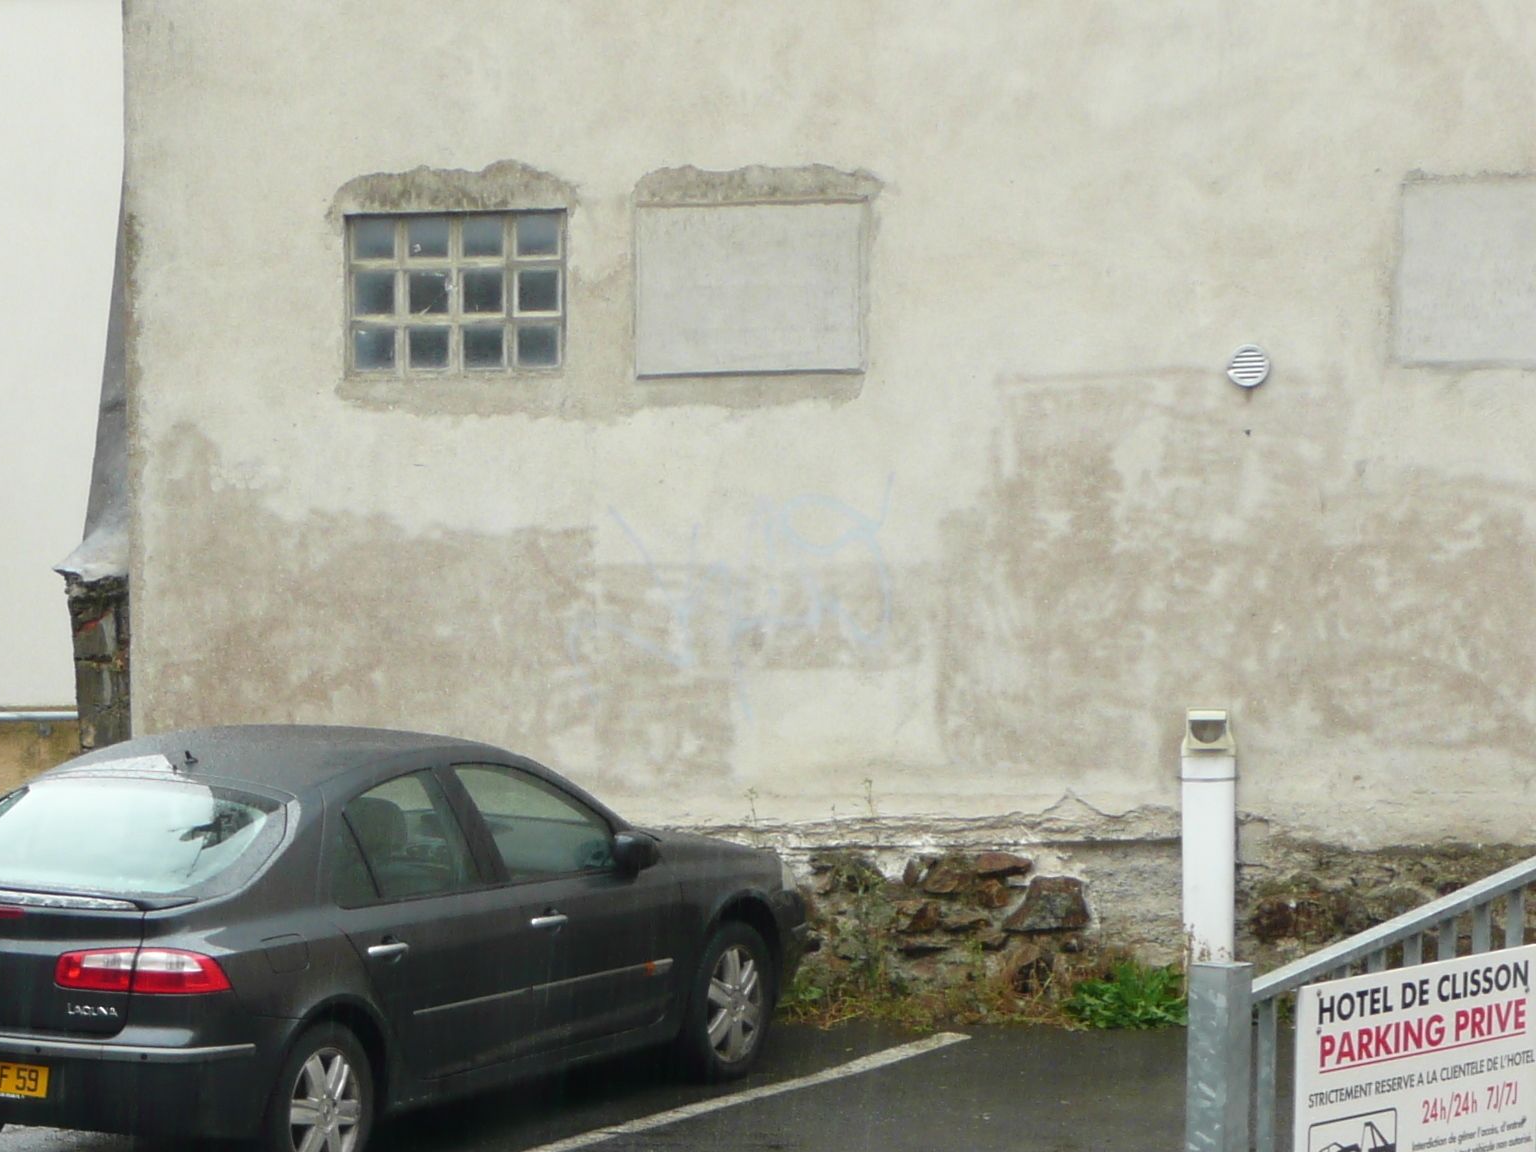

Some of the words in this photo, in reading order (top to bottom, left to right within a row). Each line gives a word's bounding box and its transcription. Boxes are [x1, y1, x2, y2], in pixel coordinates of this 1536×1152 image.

[1318, 986, 1393, 1025] HOTEL
[1401, 979, 1430, 1009] DE
[1437, 960, 1529, 1002] CLISSON
[1320, 1014, 1446, 1068] PARKING
[1455, 998, 1526, 1042] PRIVE
[15, 1067, 39, 1092] 59
[1308, 1082, 1372, 1109] STRICTEMENT
[1375, 1074, 1415, 1094] RESERVE
[1417, 1073, 1425, 1087] A
[1426, 1069, 1438, 1084] LA
[1440, 1060, 1484, 1081] CLIENTELE
[1486, 1057, 1498, 1071] DE
[1500, 1050, 1535, 1069] L'HOTEL
